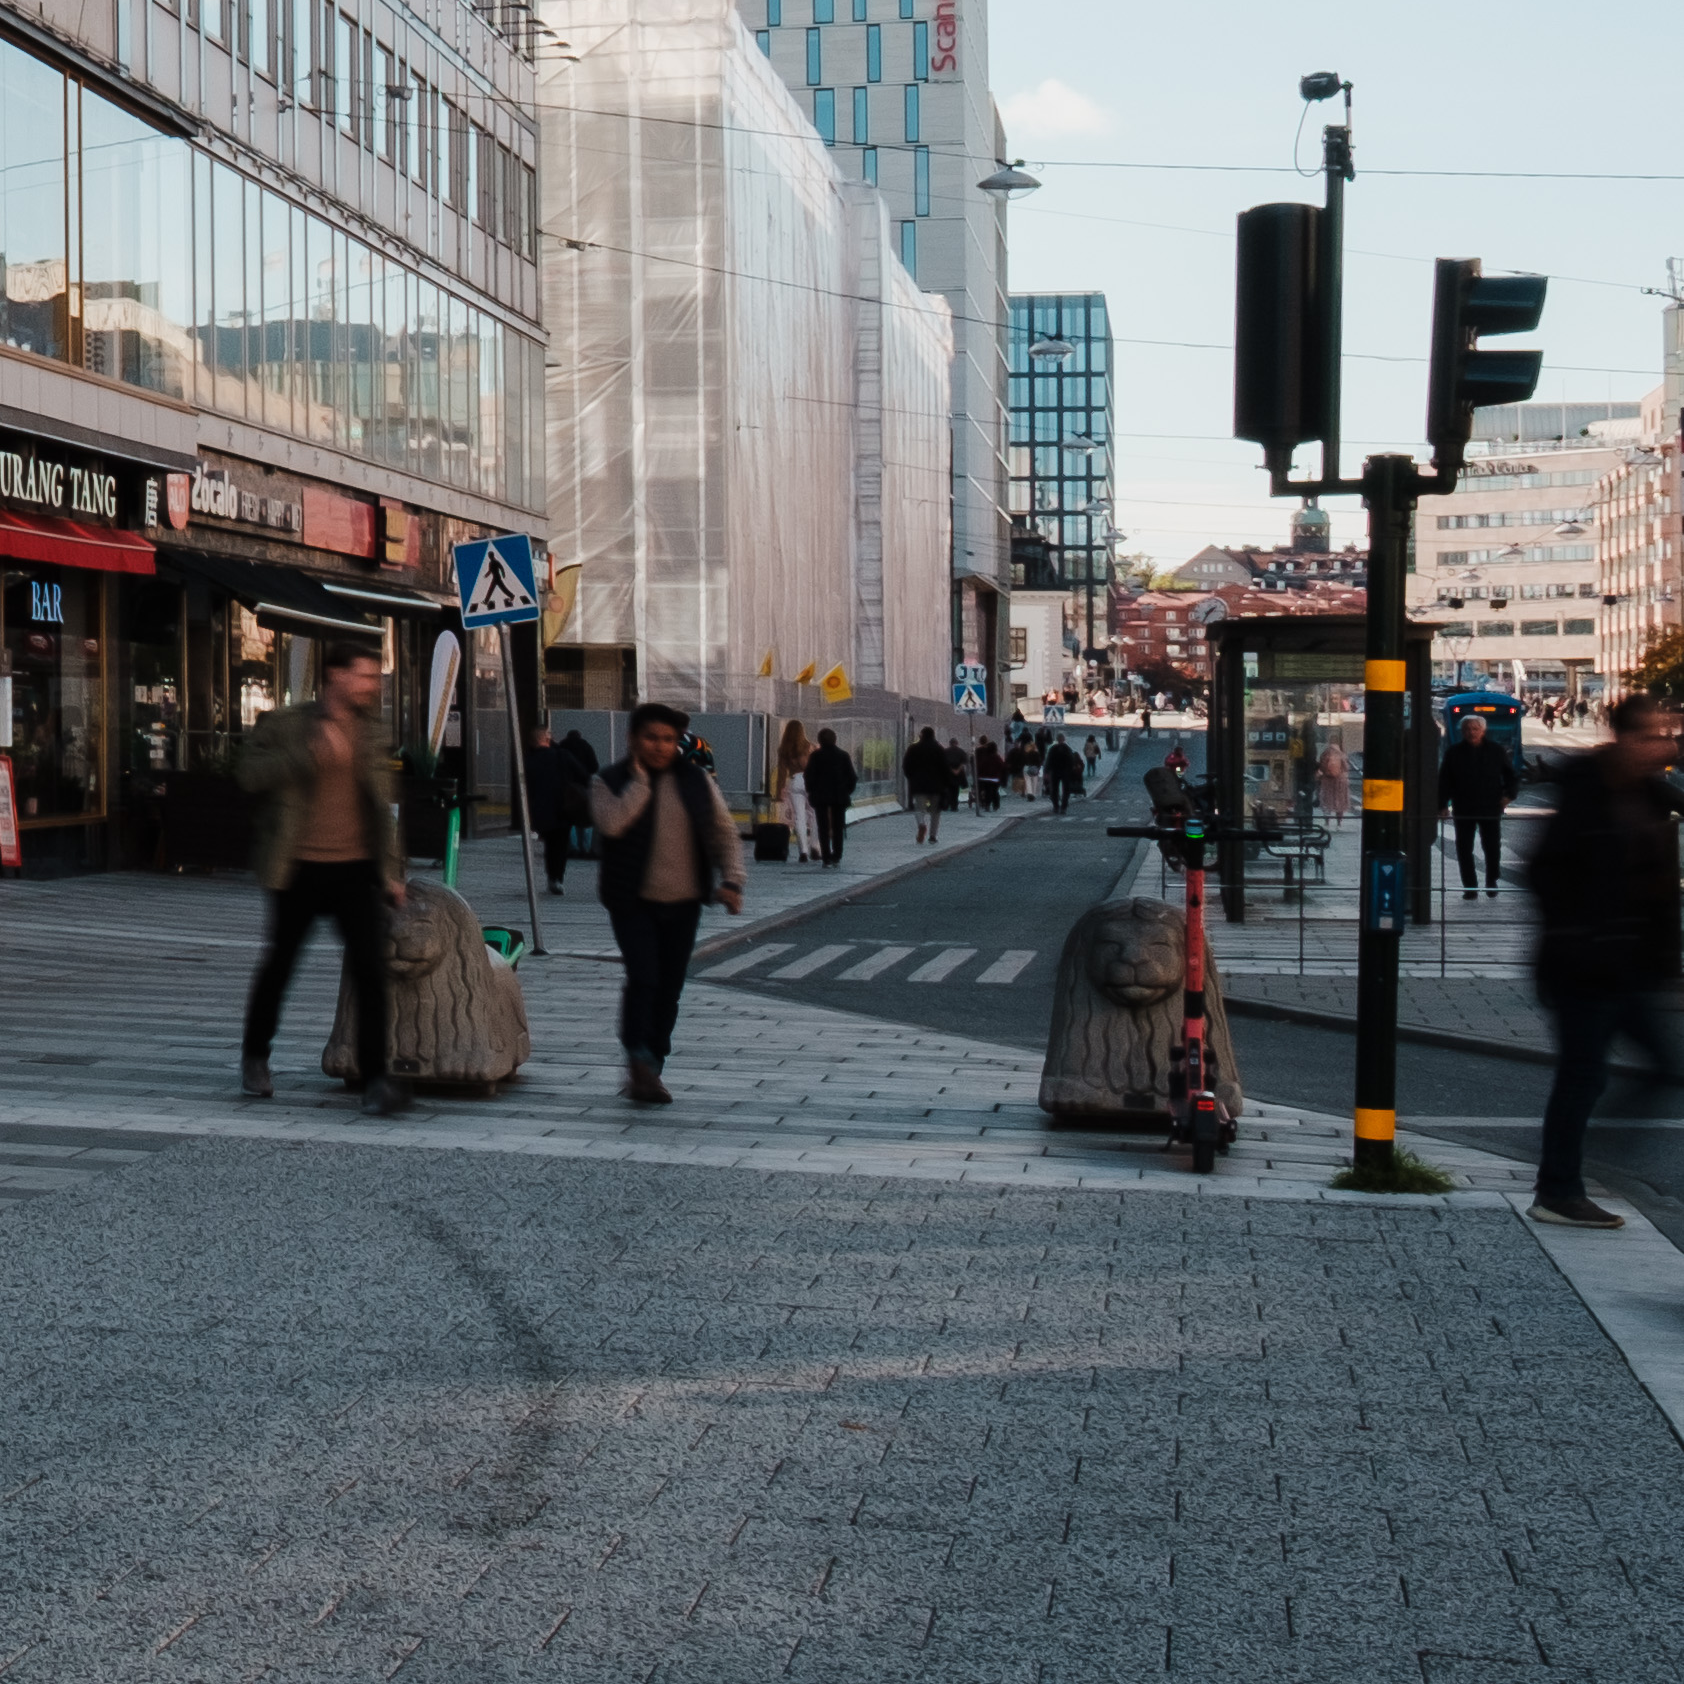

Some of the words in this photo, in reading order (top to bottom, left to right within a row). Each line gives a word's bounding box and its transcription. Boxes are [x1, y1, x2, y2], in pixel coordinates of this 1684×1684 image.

[69, 466, 117, 518] TANG
[191, 460, 238, 520] Zócalo
[30, 580, 64, 625] BAR
